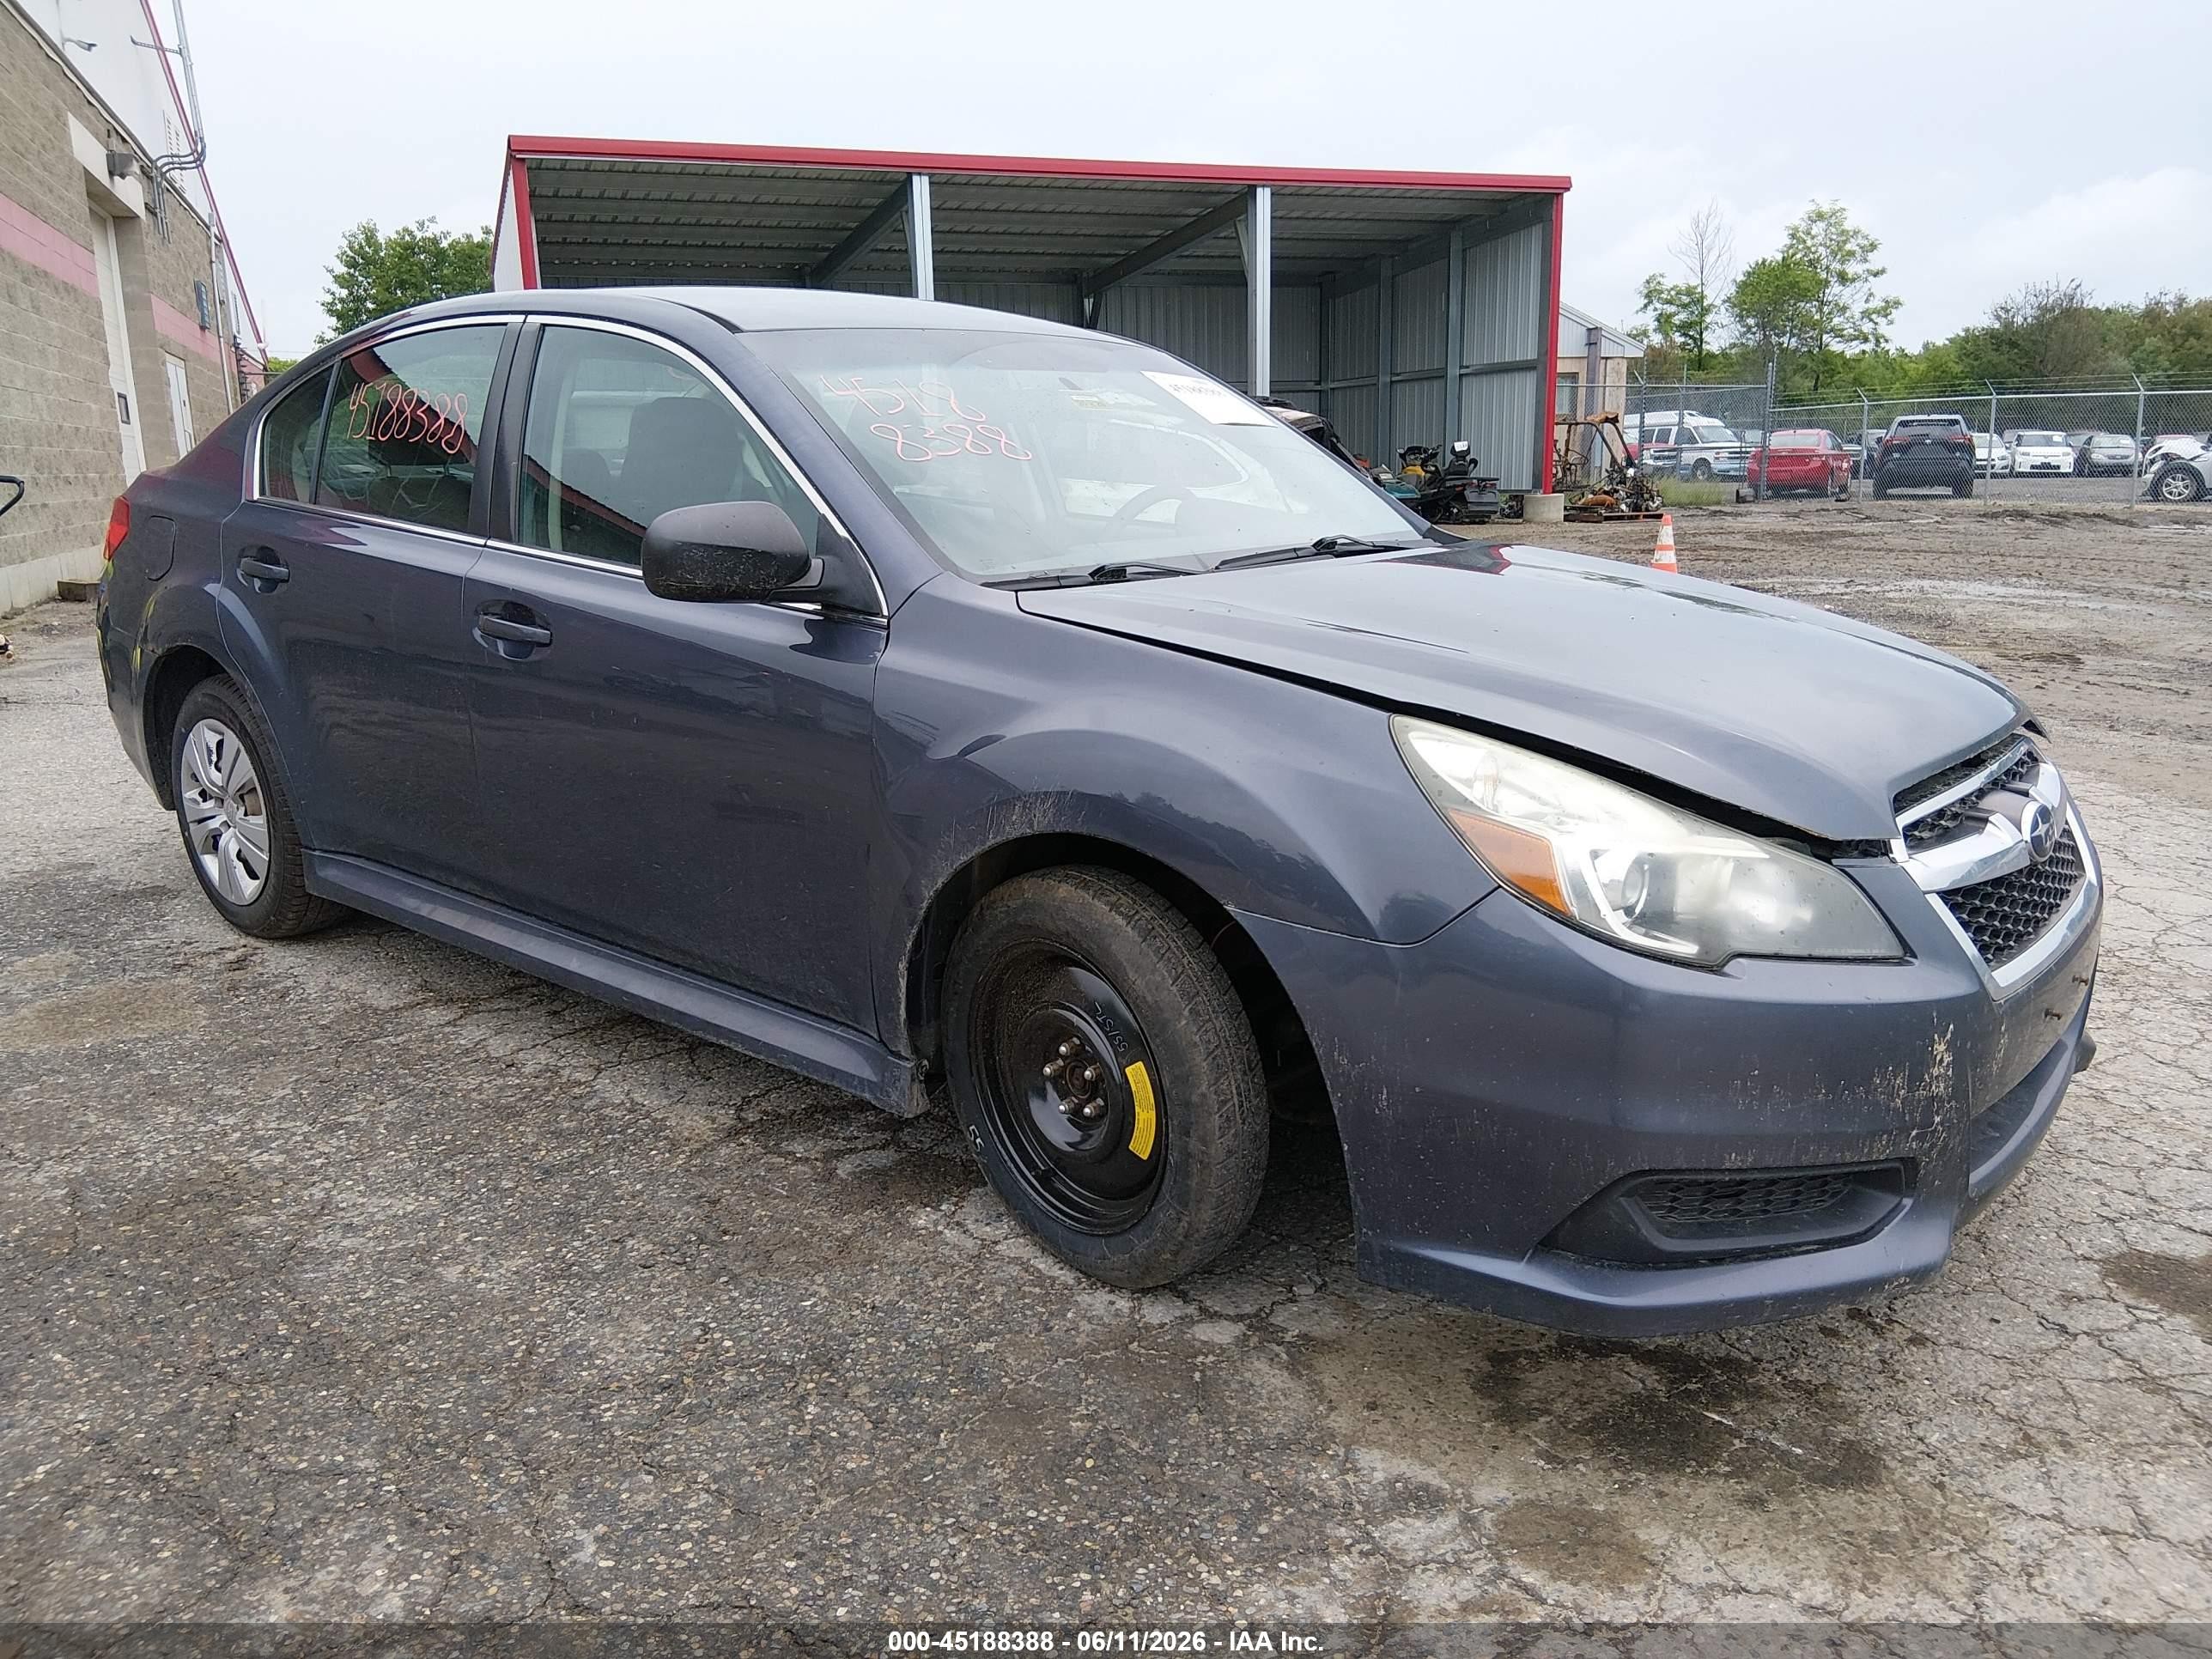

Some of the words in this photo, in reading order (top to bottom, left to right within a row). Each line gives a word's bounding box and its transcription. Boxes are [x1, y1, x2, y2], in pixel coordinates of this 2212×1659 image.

[347, 382, 468, 454] 45188388
[819, 374, 987, 422] 4518
[869, 423, 1033, 462] 8388
